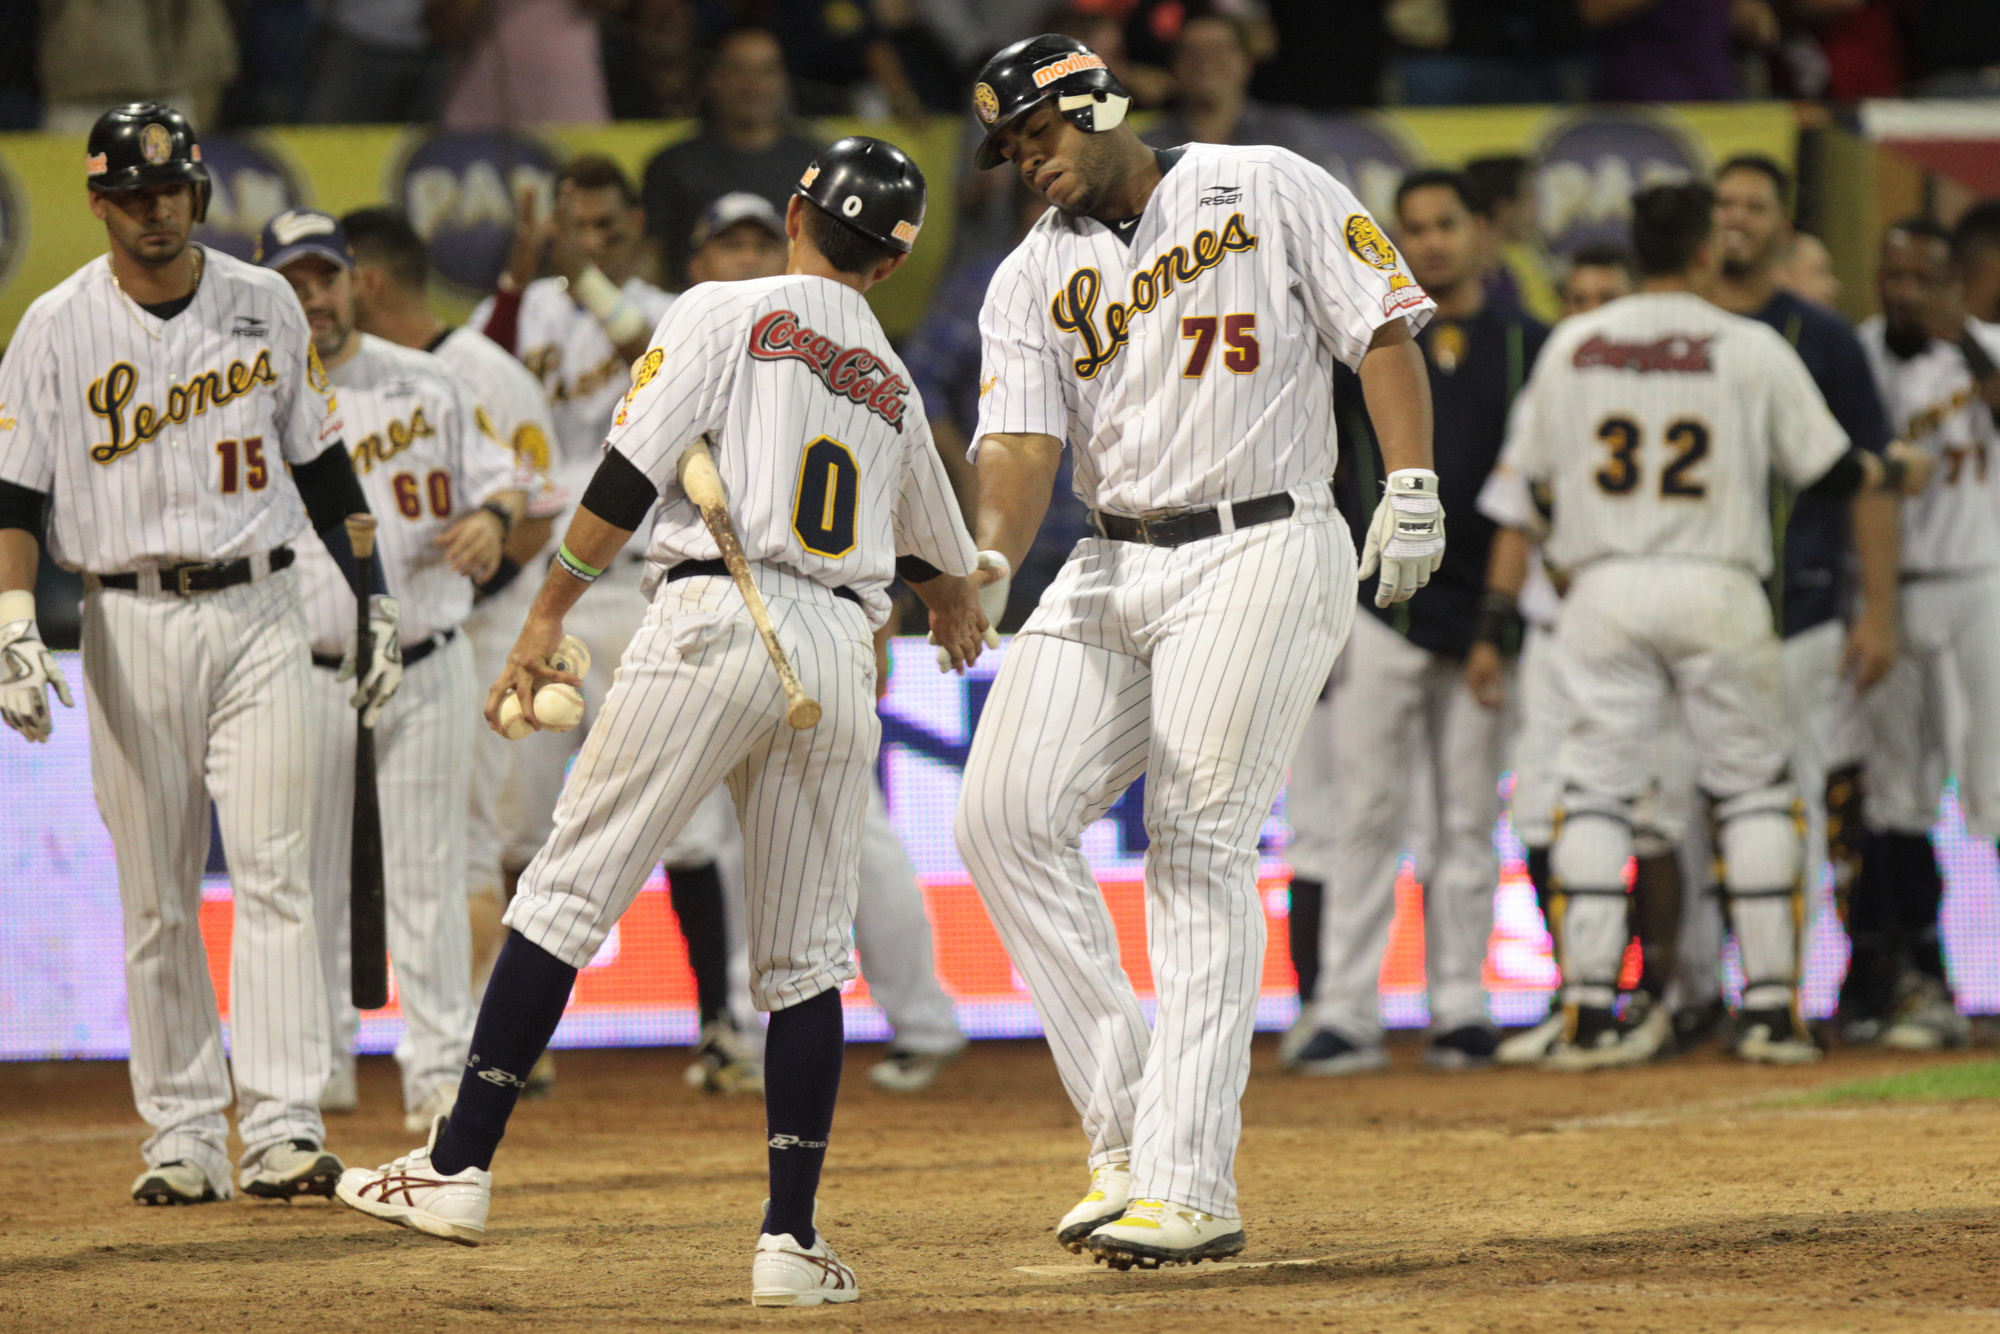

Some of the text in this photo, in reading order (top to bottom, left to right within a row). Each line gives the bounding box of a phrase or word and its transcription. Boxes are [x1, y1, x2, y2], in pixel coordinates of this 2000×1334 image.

[842, 195, 862, 217] 0
[1051, 212, 1258, 380] Leones
[748, 309, 910, 434] Coca-Cola
[1181, 312, 1260, 379] 75
[87, 348, 278, 464] Leones
[215, 435, 268, 494] 15
[392, 466, 452, 521] 60
[791, 433, 861, 560] 0
[1594, 411, 1711, 499] 32
